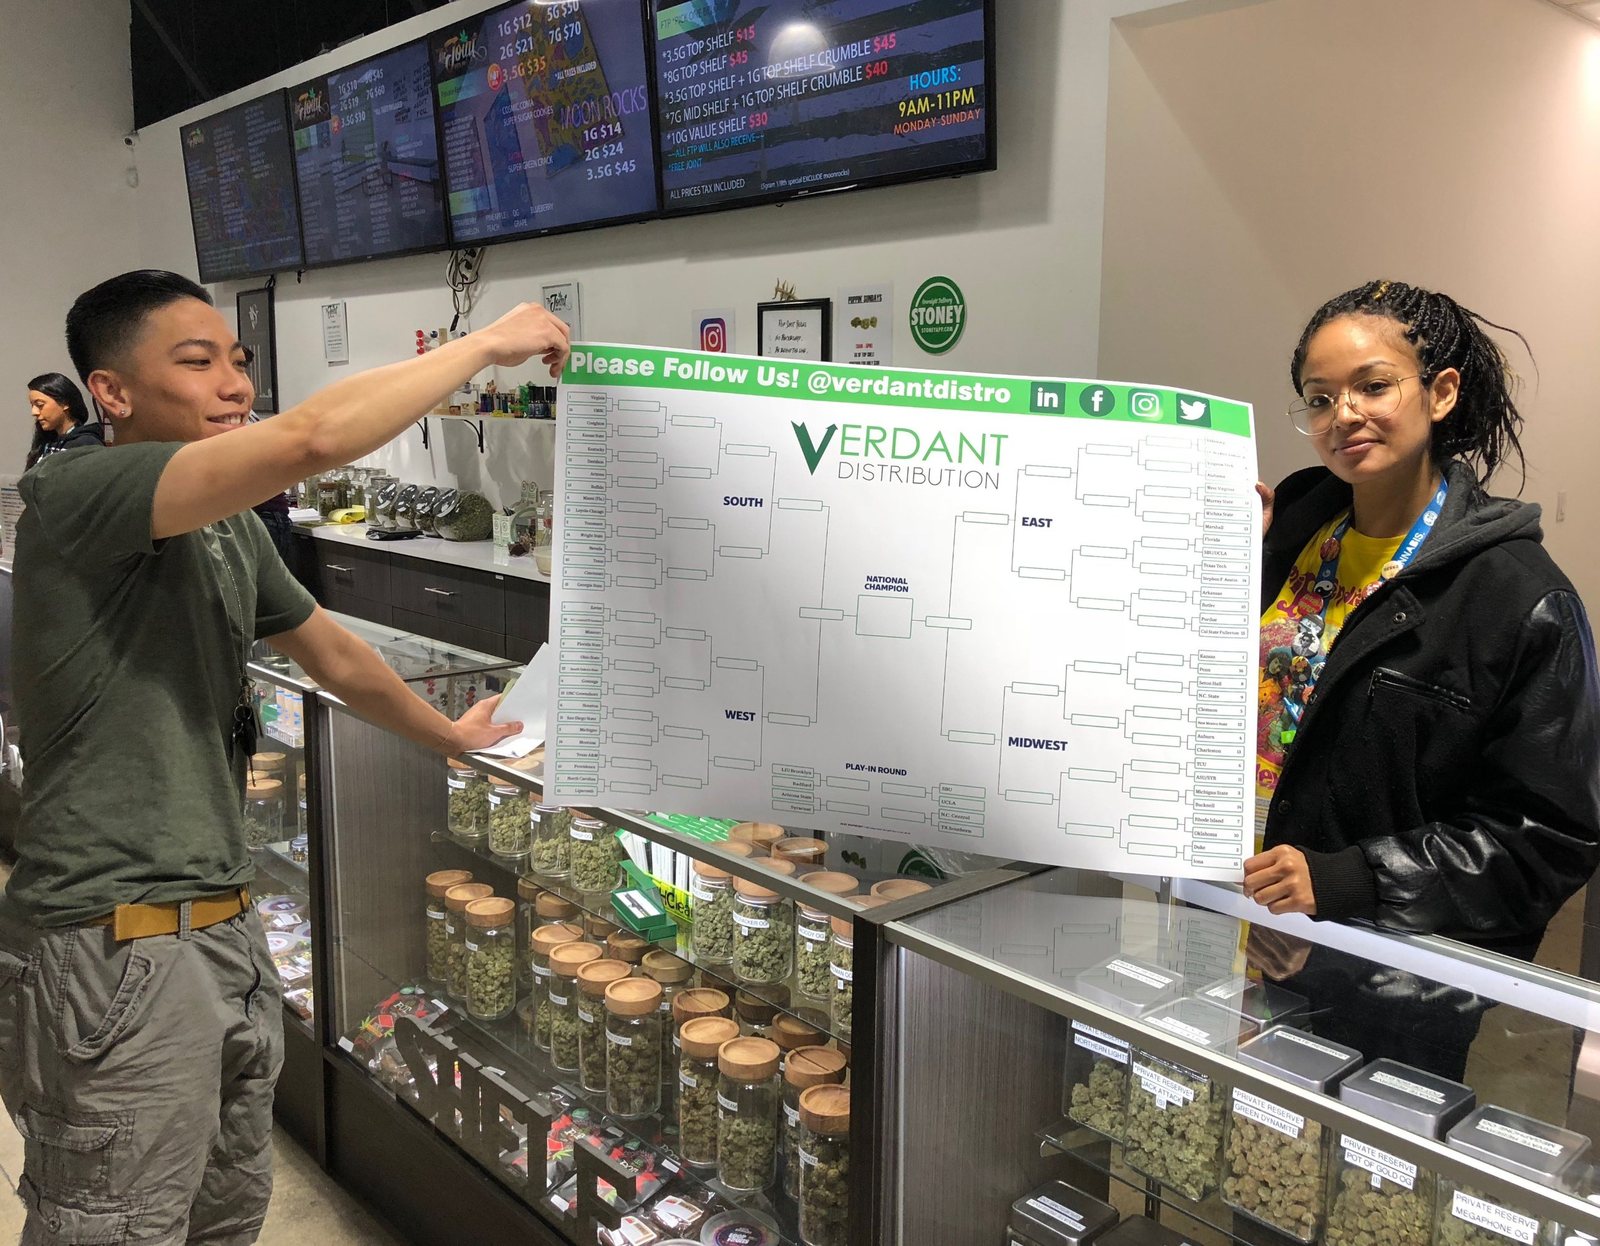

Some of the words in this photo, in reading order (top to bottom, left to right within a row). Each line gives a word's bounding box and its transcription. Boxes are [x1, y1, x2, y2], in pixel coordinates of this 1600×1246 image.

[498, 23, 511, 37] 1G
[514, 13, 532, 34] $12
[547, 7, 559, 22] 5G
[549, 29, 561, 44] 7G
[563, 22, 581, 40] $70
[688, 41, 705, 57] TOP
[706, 31, 734, 51] SHELF
[736, 25, 756, 42] $15
[500, 44, 513, 60] 2G
[516, 37, 534, 55] $21
[502, 66, 525, 83] 3.5G
[526, 56, 546, 76] $35
[681, 64, 698, 80] TOP
[700, 54, 727, 75] SHELF
[729, 50, 748, 68] $45
[690, 82, 706, 99] TOP
[709, 73, 736, 94] SHELF
[738, 77, 745, 86] +
[748, 69, 761, 84] 1G
[762, 63, 781, 79] TOP
[784, 54, 815, 76] SHELF
[818, 39, 870, 66] CRUMBLE
[873, 33, 896, 53] $45
[909, 65, 961, 91] HOURS:
[683, 105, 700, 121] MID
[702, 97, 730, 118] SHELF
[732, 101, 739, 110] +
[741, 93, 754, 107] 1G
[756, 88, 774, 103] TOP
[778, 78, 808, 99] SHELF
[810, 65, 863, 92] CRUMBLE
[865, 60, 889, 79] $40
[899, 87, 975, 117] 9AM-11PM
[560, 101, 601, 129] MOON
[604, 85, 647, 117] ROCKS
[584, 129, 598, 142] 1G
[601, 122, 621, 138] $14
[689, 123, 716, 140] VALUE
[719, 116, 746, 135] SHELF
[749, 112, 768, 129] $30
[894, 109, 981, 135] MONDAY-SUNDAY
[585, 149, 599, 161] 2G
[602, 142, 624, 158] $24
[713, 138, 729, 150] ALSO
[587, 166, 612, 180] 3.5G
[615, 159, 636, 176] $45
[803, 173, 822, 183] EXCLUDE
[670, 190, 680, 199] ALL
[681, 187, 700, 198] PRICES
[701, 184, 713, 194] TAX
[714, 179, 745, 193] INCLUDED
[911, 304, 963, 326] STONEY
[570, 351, 655, 376] Please
[663, 357, 748, 384] Follow
[757, 366, 799, 389] Us!
[807, 371, 1011, 405] @verdantdistro
[790, 420, 1009, 477] VERDANT
[837, 461, 1000, 490] DISTRIBUTION
[723, 495, 764, 508] SOUTH
[1021, 516, 1053, 528] EAST
[1399, 532, 1426, 567] NNABIS.
[864, 583, 909, 593] CHAMPION
[866, 575, 908, 585] NATIONAL
[725, 709, 756, 722] WEST
[1008, 736, 1068, 751] MIDWEST
[845, 762, 877, 774] PLAY-IN
[878, 766, 907, 777] ROUND
[1076, 1035, 1107, 1053] NORTHERN
[1143, 1081, 1156, 1092] JACK
[1158, 1089, 1181, 1104] ATTACK
[1235, 1103, 1259, 1118] GREEN
[1261, 1114, 1297, 1135] DYNAMITE
[1344, 1138, 1376, 1157] PRIVATE
[1378, 1153, 1414, 1174] RESERVE
[1347, 1152, 1362, 1162] POT
[1364, 1160, 1374, 1168] OF
[1377, 1165, 1398, 1179] GOLD
[1399, 1175, 1412, 1186] OG
[1456, 1194, 1492, 1213] PRIVATE
[1495, 1208, 1536, 1230] RESERVE
[1456, 1206, 1512, 1234] MEGAPHONE
[1515, 1230, 1528, 1240] OG
